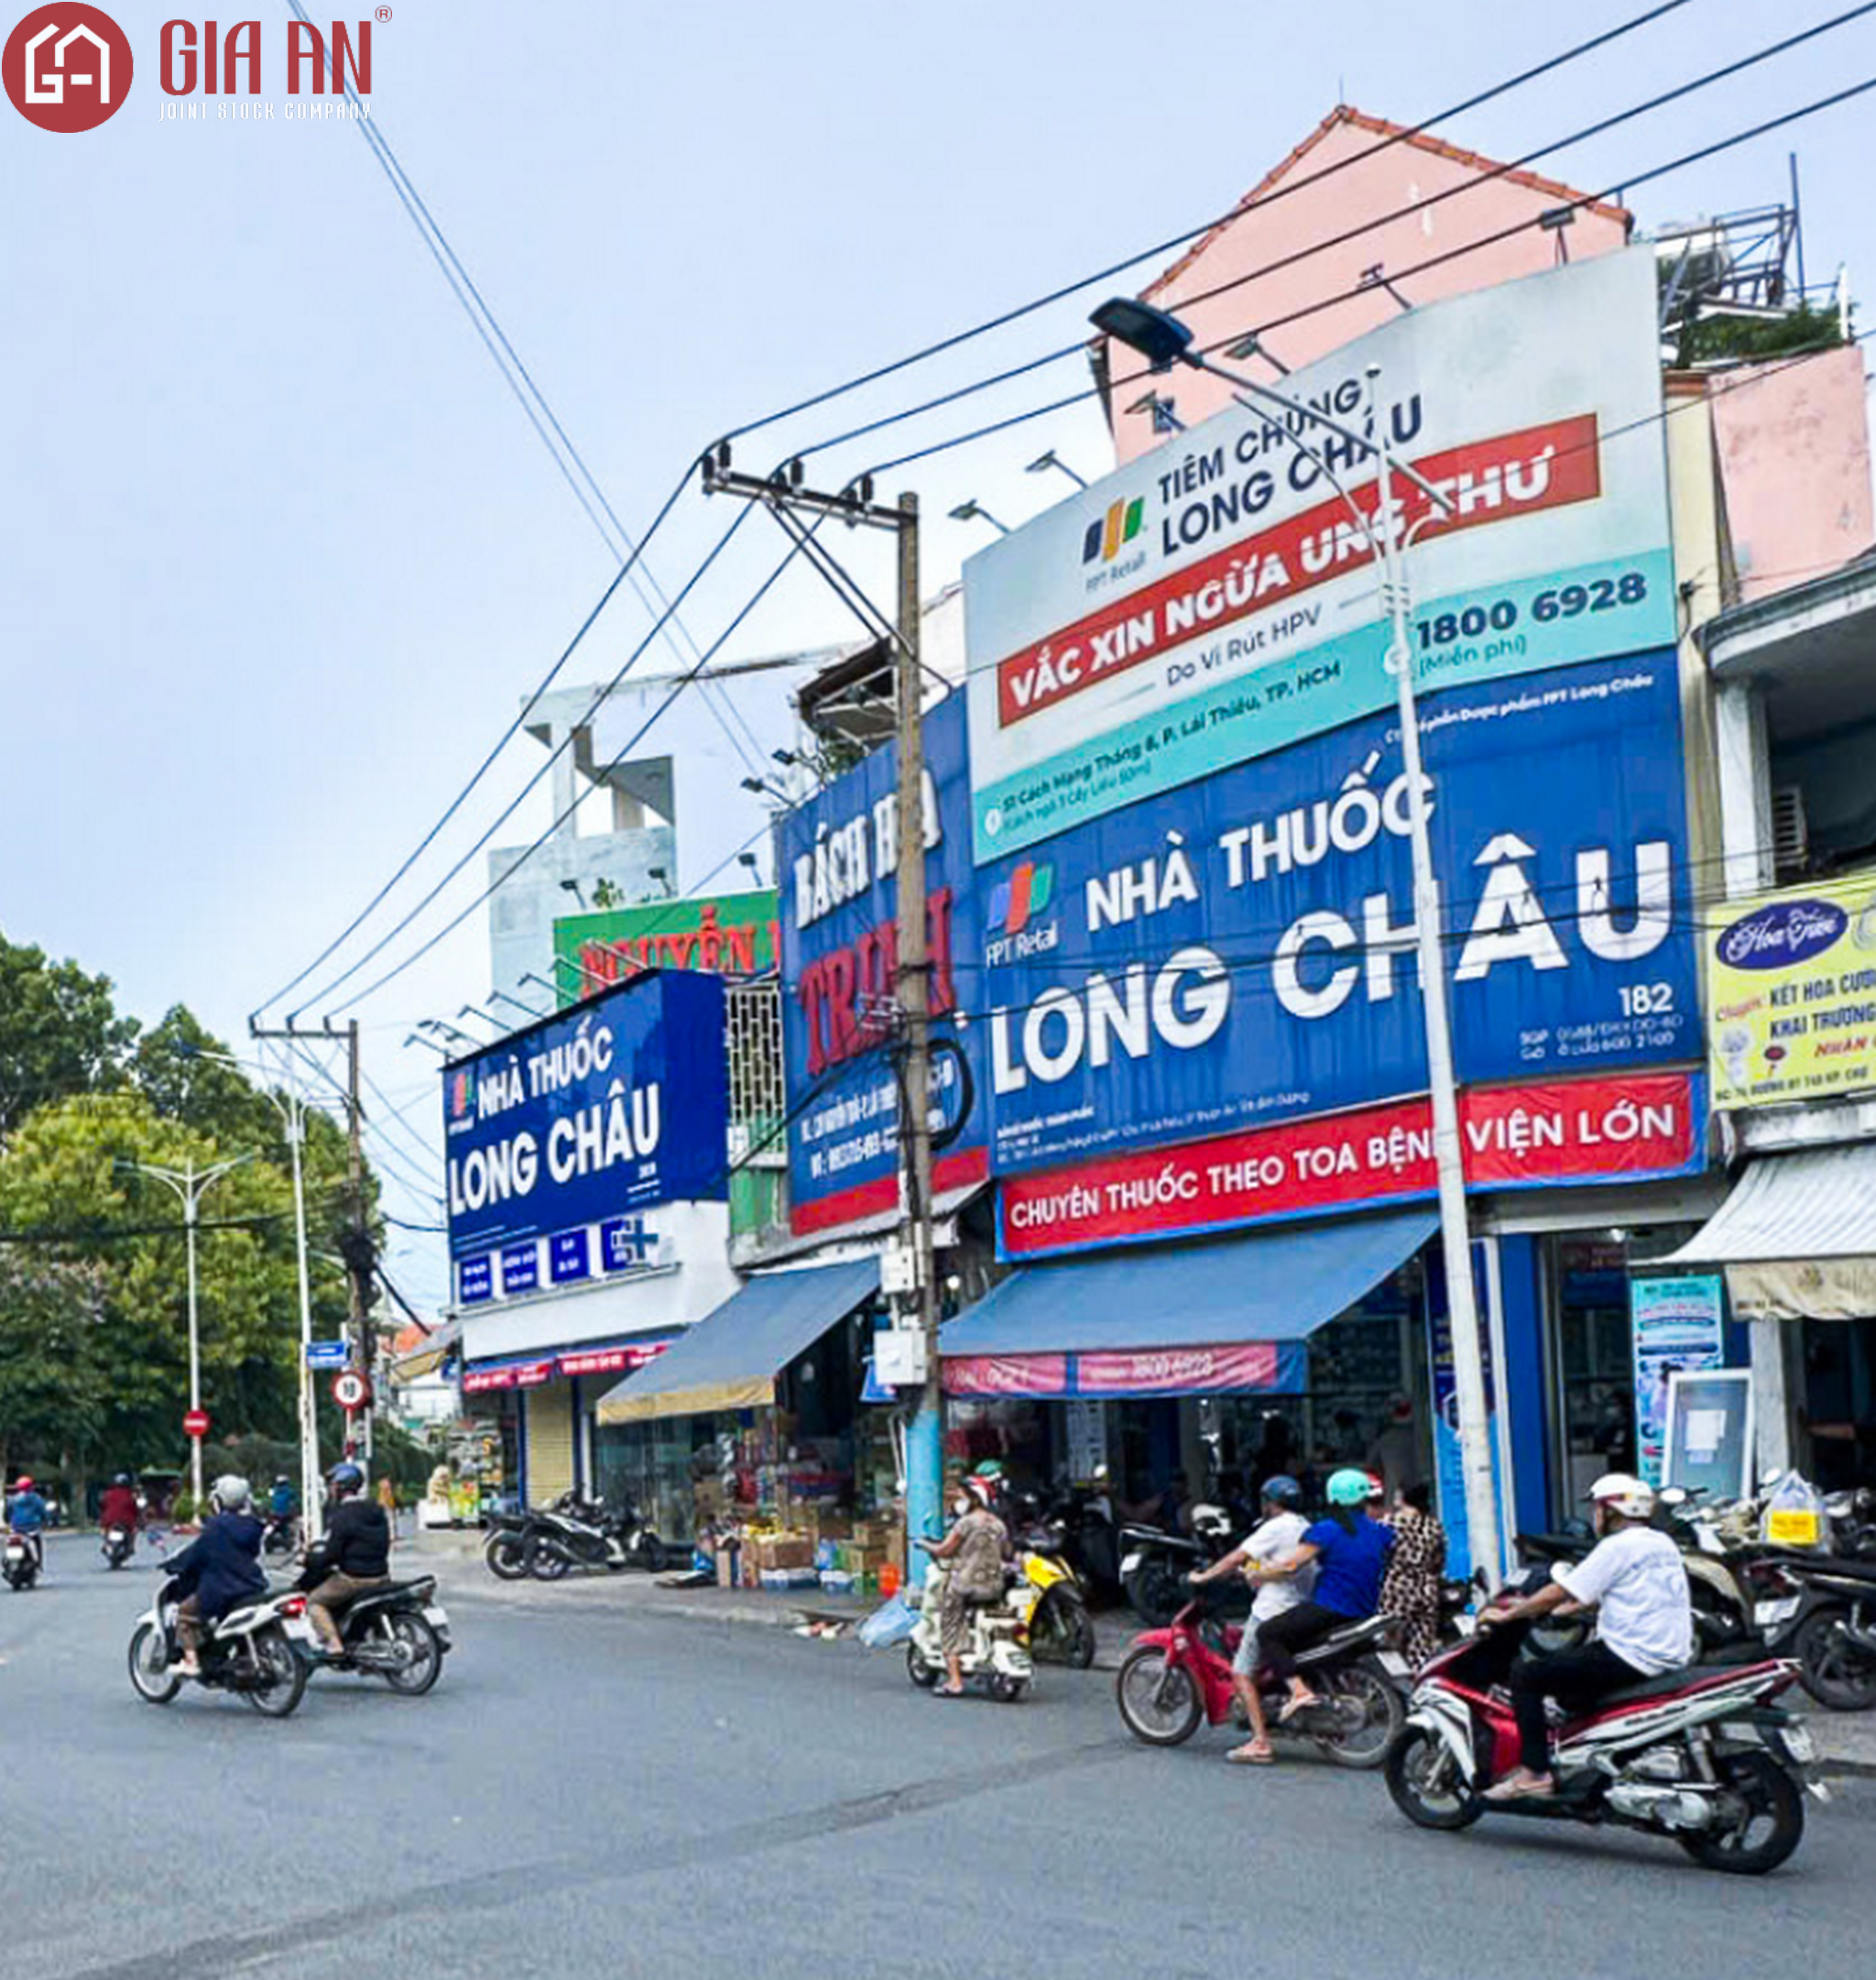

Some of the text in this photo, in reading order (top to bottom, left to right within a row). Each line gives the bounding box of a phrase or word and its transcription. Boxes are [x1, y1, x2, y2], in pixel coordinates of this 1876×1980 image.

[1158, 446, 1224, 505] TIÊM
[1162, 470, 1274, 556] LONG
[1110, 552, 1146, 584] Retail
[1009, 644, 1081, 707] VẮC
[1090, 612, 1155, 672] XIN
[1165, 553, 1290, 636] NGỪA
[1167, 662, 1196, 686] Do
[1227, 630, 1267, 662] Rút
[1271, 604, 1323, 642] HPV
[1417, 572, 1648, 650] 1800 6928
[1296, 659, 1342, 693] HCM
[1571, 683, 1609, 701] Long
[793, 821, 870, 929] BÁCH
[1086, 749, 1436, 933] NHÀ THUỐC
[991, 833, 1673, 1096] LONG CHÂU
[1016, 920, 1058, 958] Retail
[1618, 982, 1674, 1017] 182
[1770, 1015, 1807, 1040] KHAI
[1804, 978, 1836, 1001] HOA
[477, 1015, 614, 1120] NHÀ THUỐC
[450, 1078, 660, 1216] LONG CHÂU
[1010, 1185, 1100, 1228] CHUYÊN
[1106, 1162, 1199, 1210] THUỐC
[1207, 1156, 1285, 1195] THEO
[1293, 1142, 1359, 1180] TOA
[1466, 1108, 1564, 1157] VIỆN
[1578, 1098, 1674, 1144] LỚN
